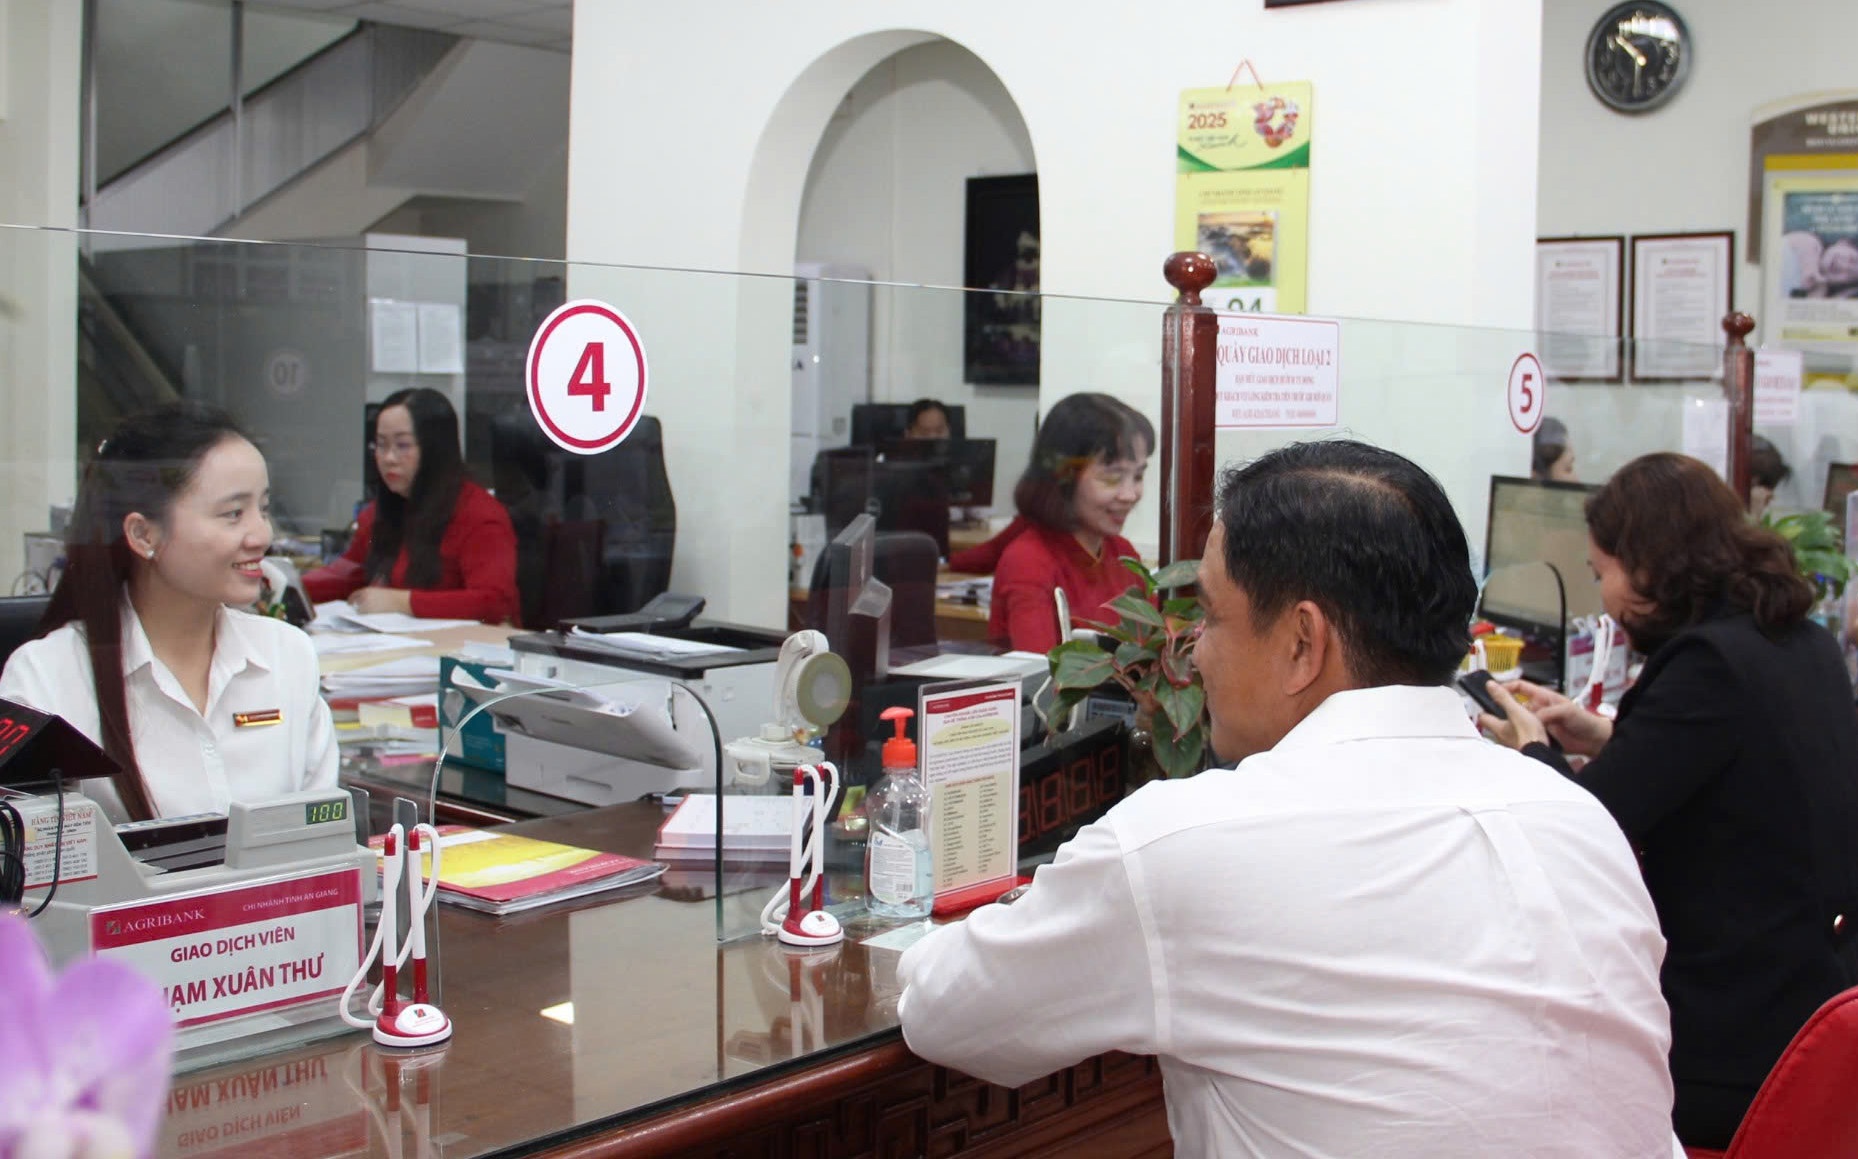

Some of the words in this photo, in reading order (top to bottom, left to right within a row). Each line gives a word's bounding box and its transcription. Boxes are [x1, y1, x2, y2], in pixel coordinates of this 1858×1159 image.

[1187, 112, 1227, 130] 2025
[567, 342, 611, 412] 4
[1248, 346, 1273, 365] GIAO
[1276, 347, 1301, 370] DỊCH
[1302, 348, 1325, 370] LOẠI
[1520, 374, 1532, 413] 5
[312, 802, 343, 822] 100
[124, 908, 205, 933] AGRIBANK
[242, 903, 256, 912] CHI
[303, 892, 314, 900] AN
[315, 888, 338, 899] GIANG
[170, 942, 212, 963] GIAO
[216, 935, 256, 957] DỊCH
[258, 926, 295, 946] VIÊN
[164, 978, 207, 1013] ẠM
[212, 965, 275, 999] XUÂN
[278, 952, 325, 985] THƯ
